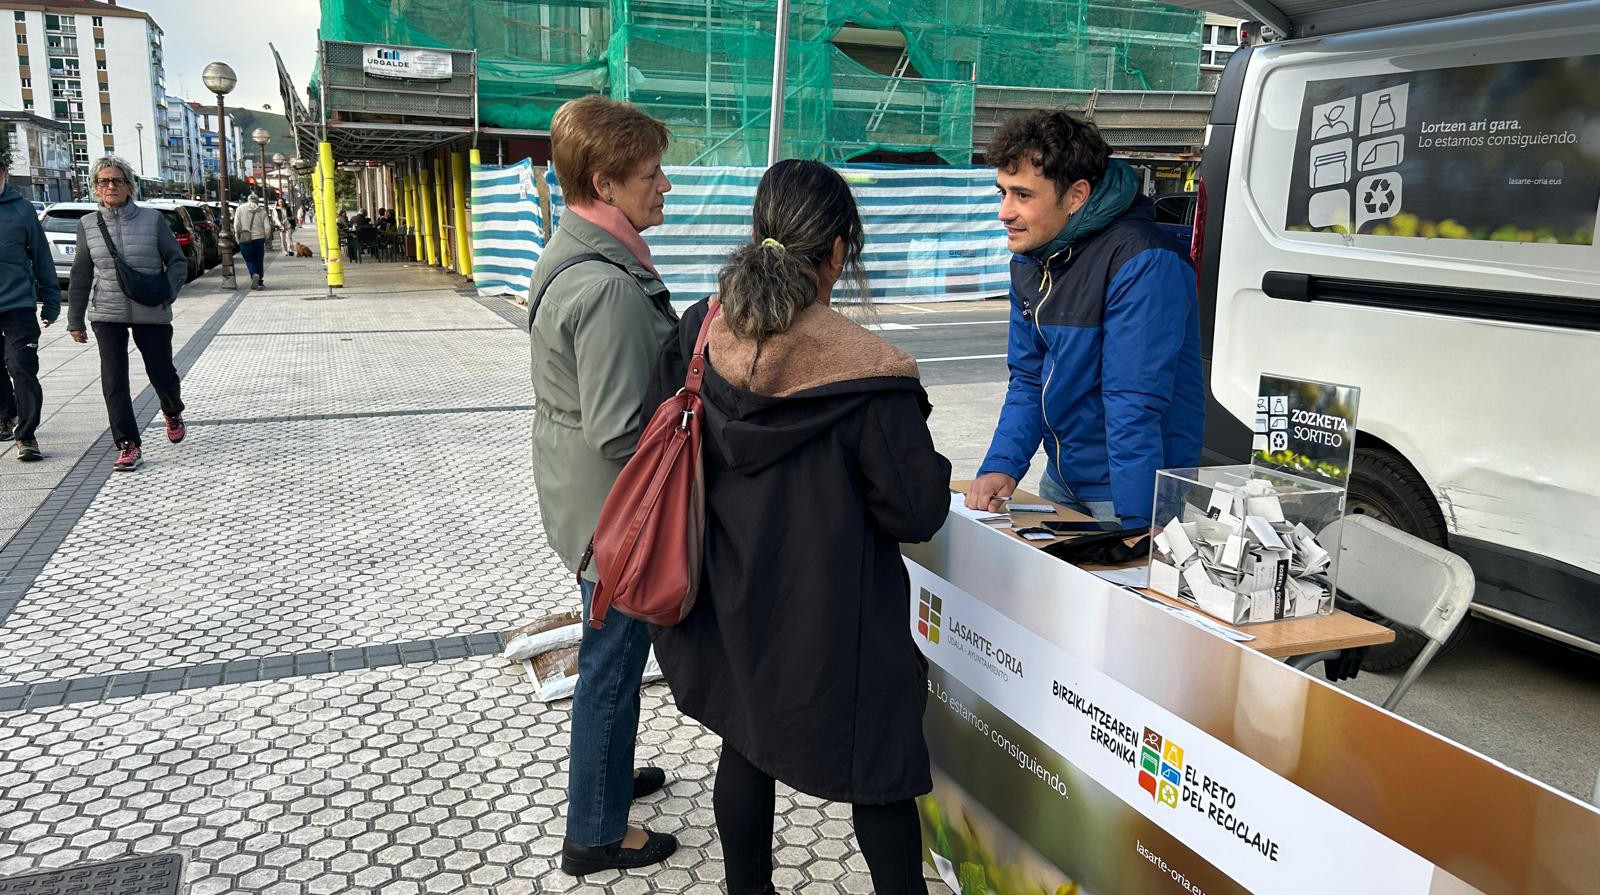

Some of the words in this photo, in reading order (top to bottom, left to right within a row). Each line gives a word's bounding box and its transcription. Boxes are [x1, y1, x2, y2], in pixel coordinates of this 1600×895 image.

[367, 58, 409, 68] URGALDE
[1418, 136, 1432, 147] Lo
[1435, 136, 1484, 147] estamos
[1487, 131, 1579, 148] consiguiendo.
[1421, 121, 1466, 133] Lortzen
[1469, 119, 1487, 131] ari
[1489, 119, 1522, 133] gara.
[1508, 177, 1562, 185] lasarte-oria.eus
[1291, 408, 1348, 432] ZOZKETA
[1293, 426, 1343, 448] SORTEO
[948, 636, 964, 651] UDALA
[967, 650, 1009, 682] AYUNTAMIENTO
[949, 617, 1023, 678] LASARTE-ORIA
[1052, 680, 1139, 748] BIRZIKLATZEAREN
[937, 683, 948, 703] Lo
[950, 698, 989, 736] estamos
[991, 730, 1069, 800] consiguiendo.
[1090, 724, 1136, 768] ERRONKA
[1185, 764, 1199, 786] EL
[1202, 775, 1236, 809] RETO
[1182, 785, 1205, 813] DEL
[1208, 802, 1279, 861] RECICLAJE
